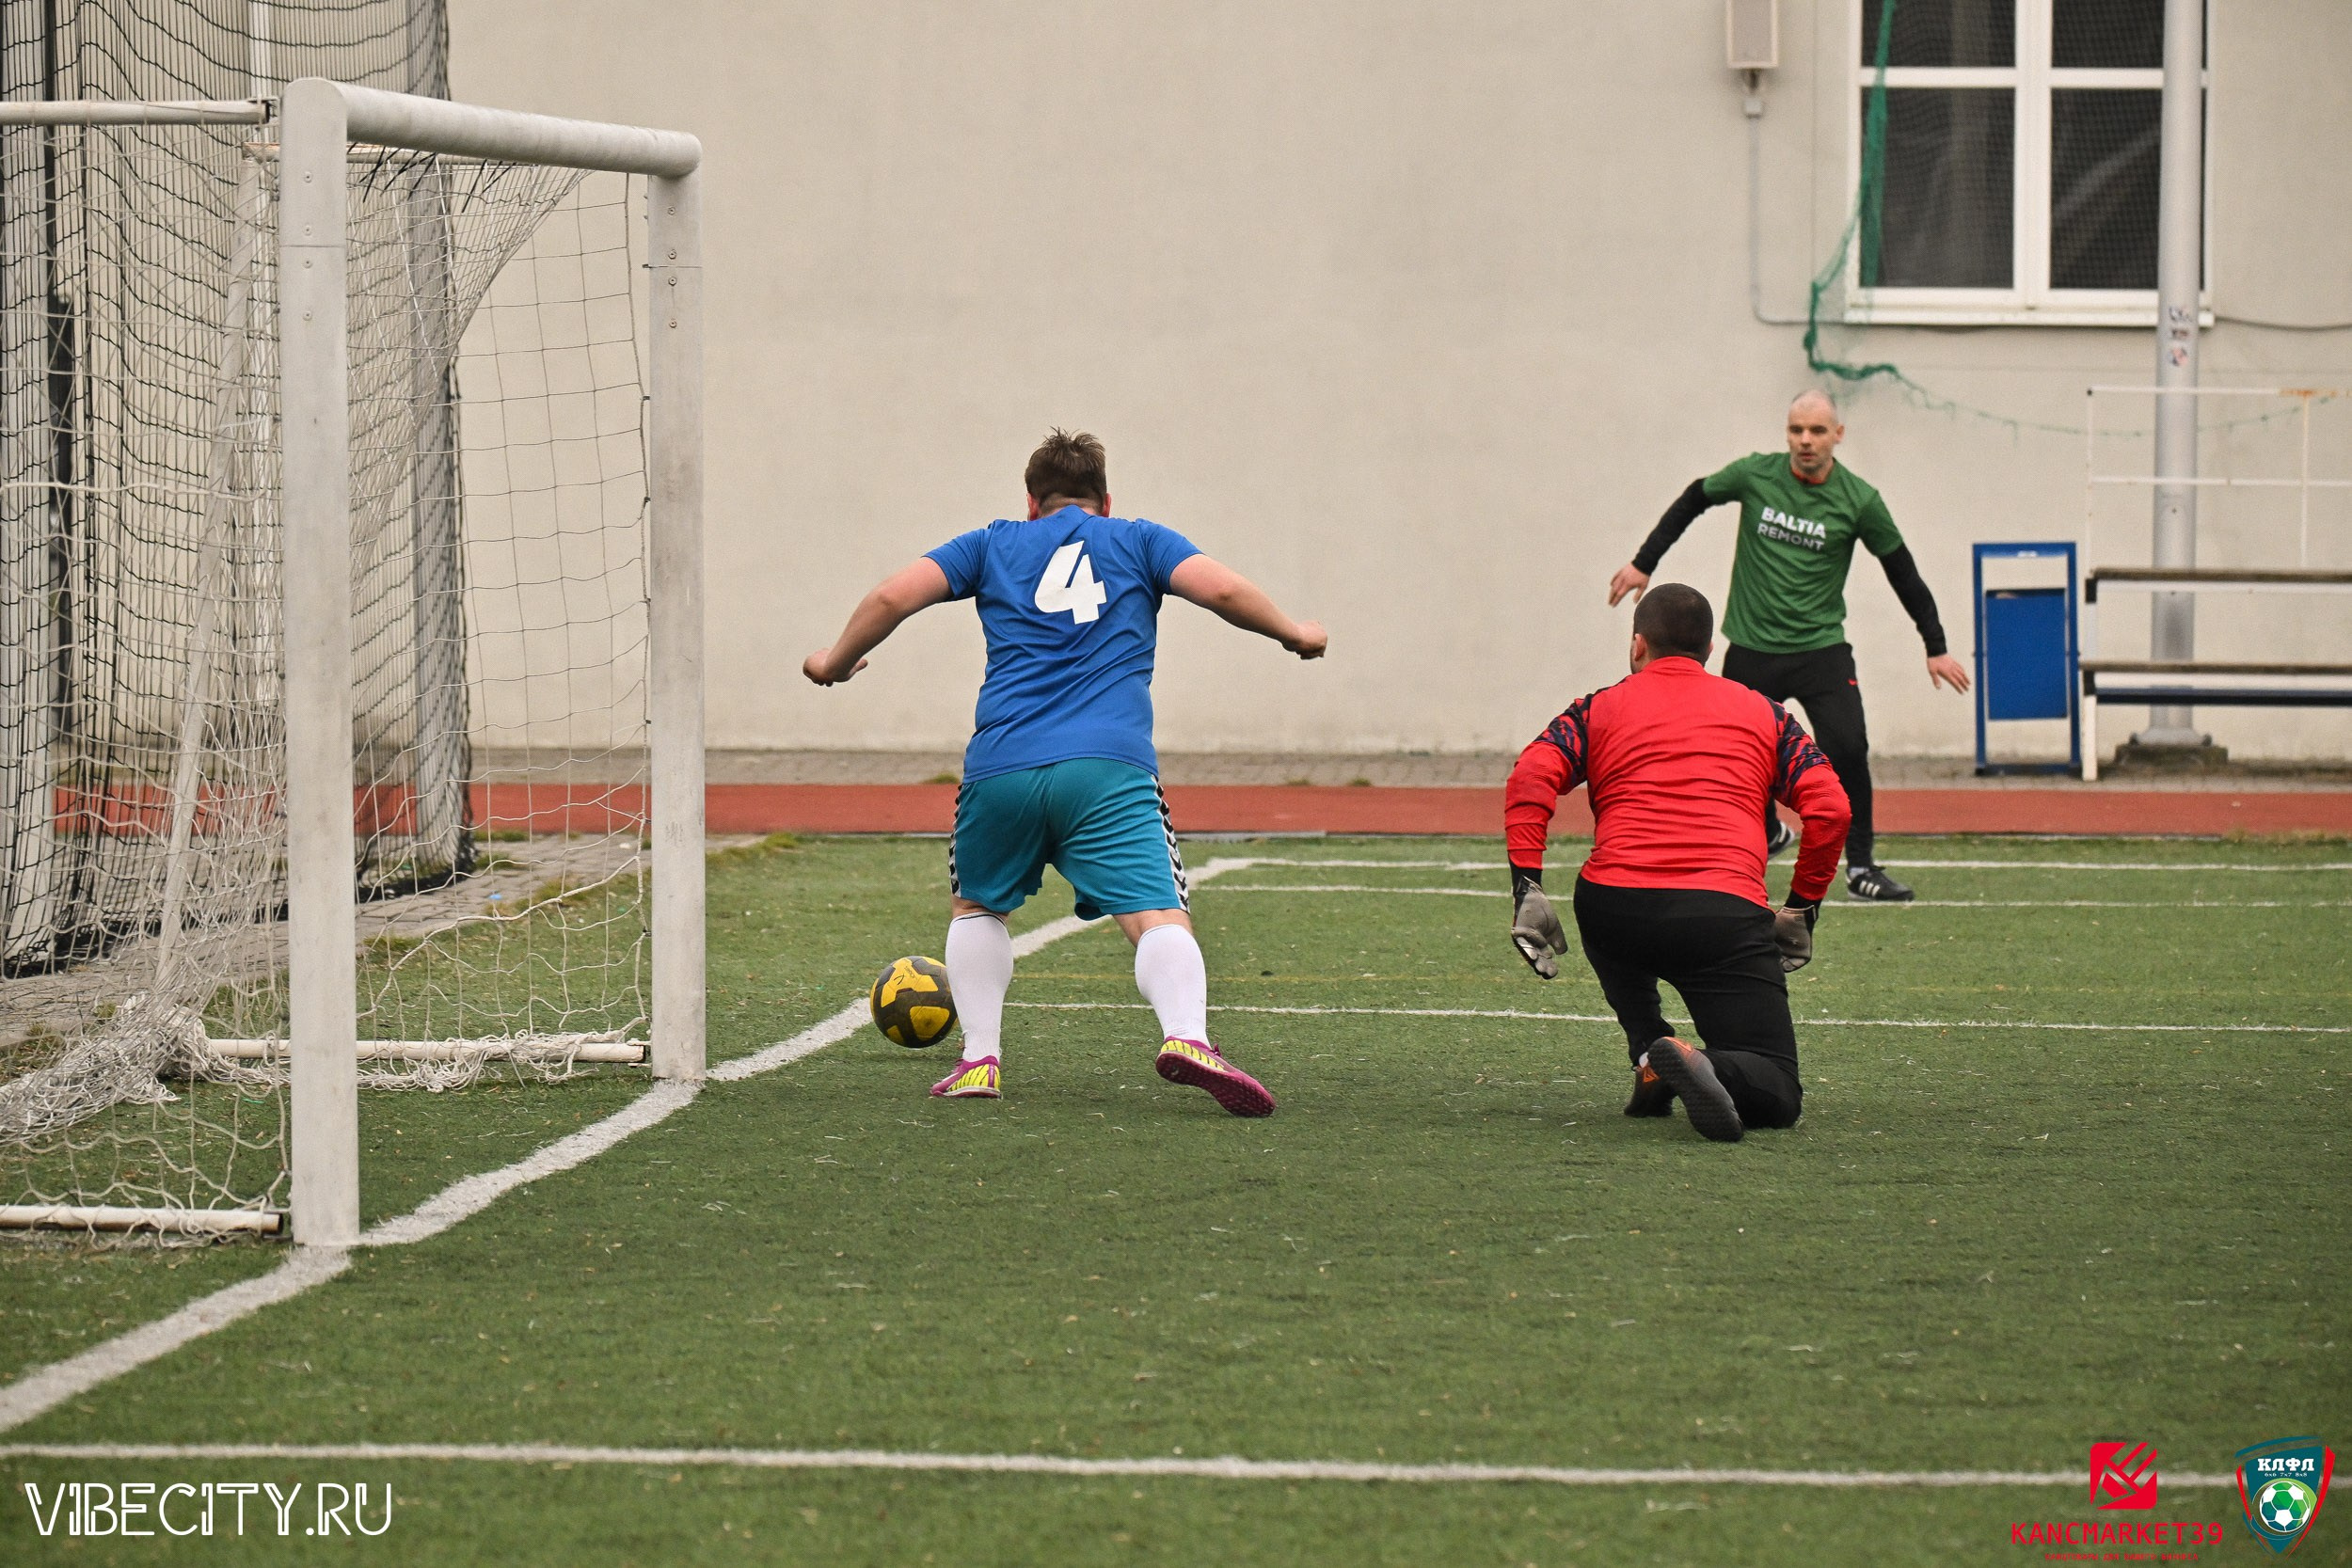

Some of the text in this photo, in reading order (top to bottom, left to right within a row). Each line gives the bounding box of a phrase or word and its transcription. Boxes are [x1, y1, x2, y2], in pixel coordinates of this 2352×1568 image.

[1757, 522, 1825, 551] REMONT
[1761, 506, 1827, 539] BALTIA
[1035, 540, 1107, 625] 4
